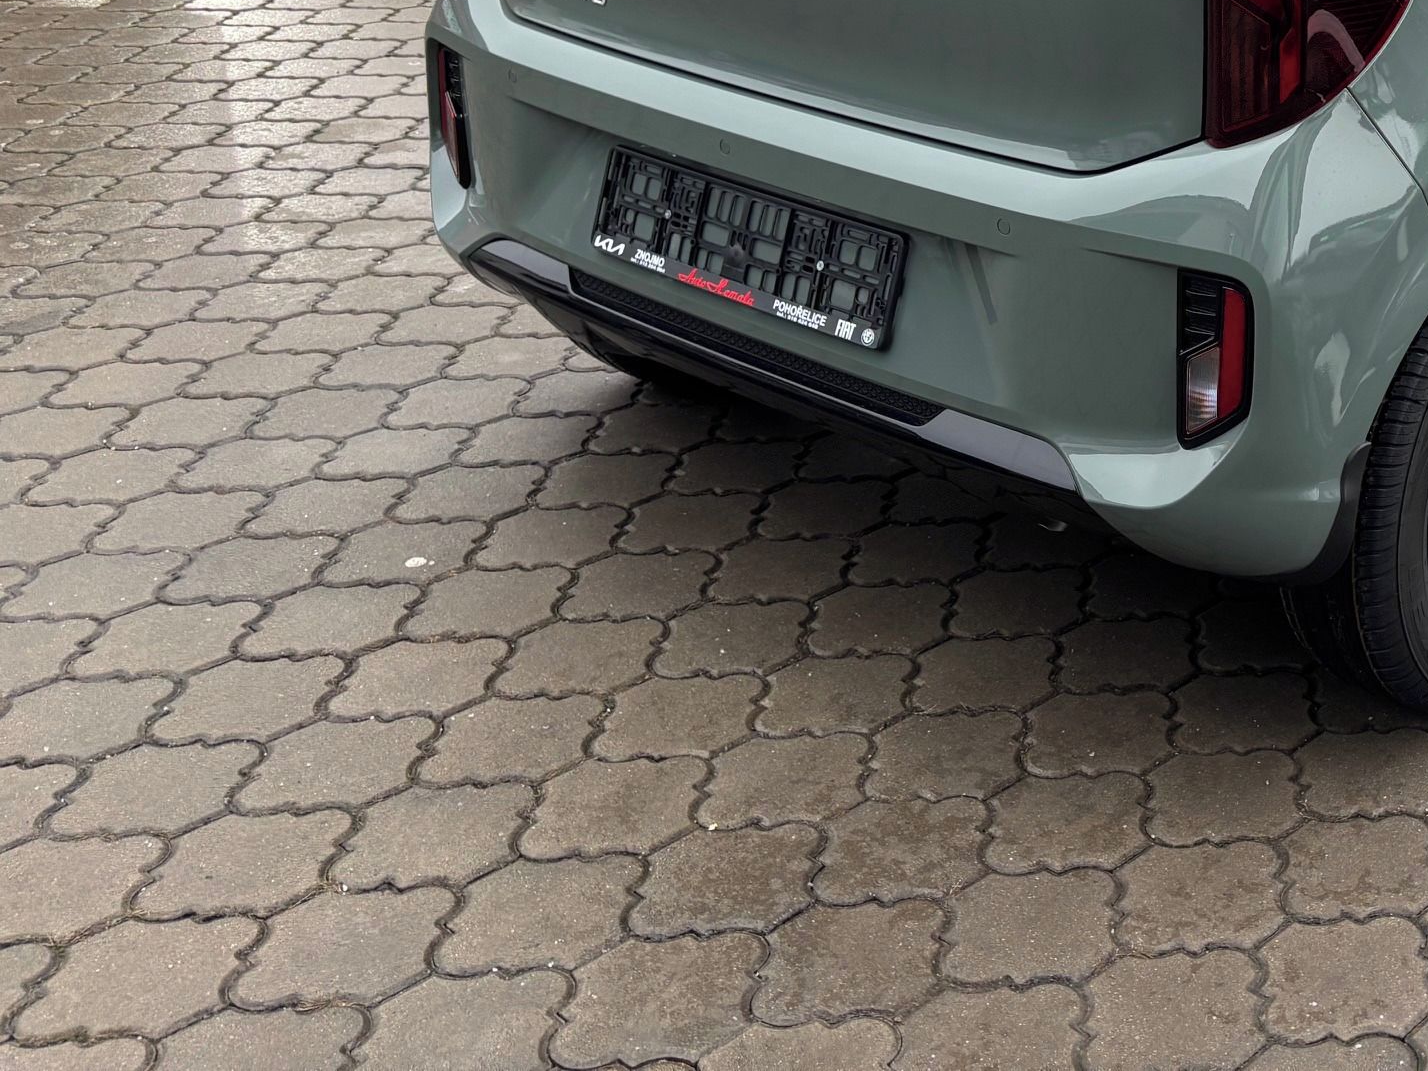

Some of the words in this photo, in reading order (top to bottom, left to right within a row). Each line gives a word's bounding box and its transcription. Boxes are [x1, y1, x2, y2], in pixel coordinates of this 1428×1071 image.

[634, 248, 665, 267] ZNOJMO
[772, 298, 828, 327] POHOŘELICE
[835, 319, 857, 340] FIAT
